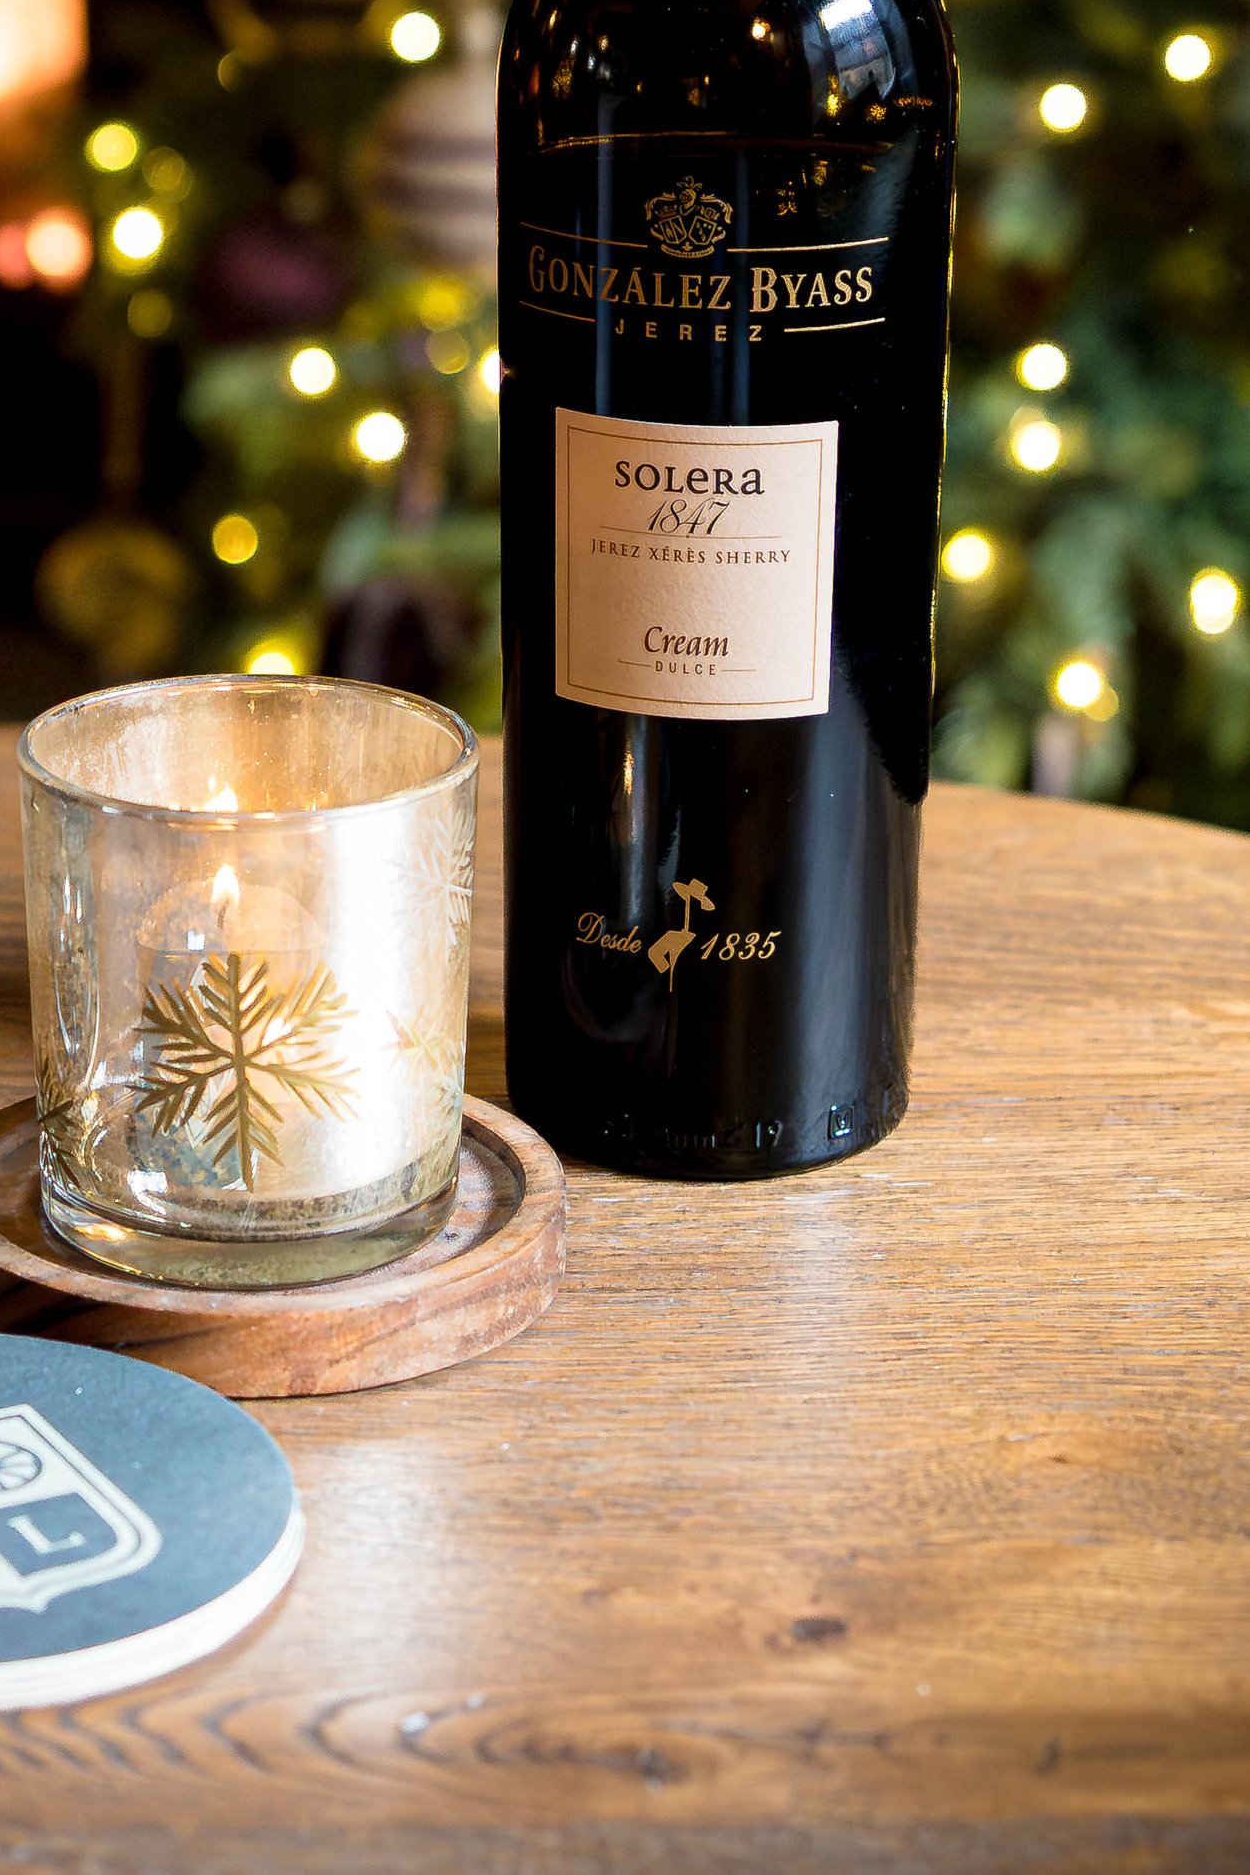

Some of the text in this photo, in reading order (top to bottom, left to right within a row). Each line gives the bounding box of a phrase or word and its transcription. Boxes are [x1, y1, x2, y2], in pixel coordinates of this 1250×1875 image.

[528, 244, 873, 313] GONZÁLEZ BYASS
[615, 319, 762, 342] JEREZ
[646, 497, 731, 536] 1847
[590, 538, 791, 565] JEREZ XÉRÈS SHERRY
[643, 625, 730, 657] Cream
[654, 660, 716, 676] DULCE
[576, 912, 783, 961] Desde 1835
[9, 1513, 85, 1556] L
